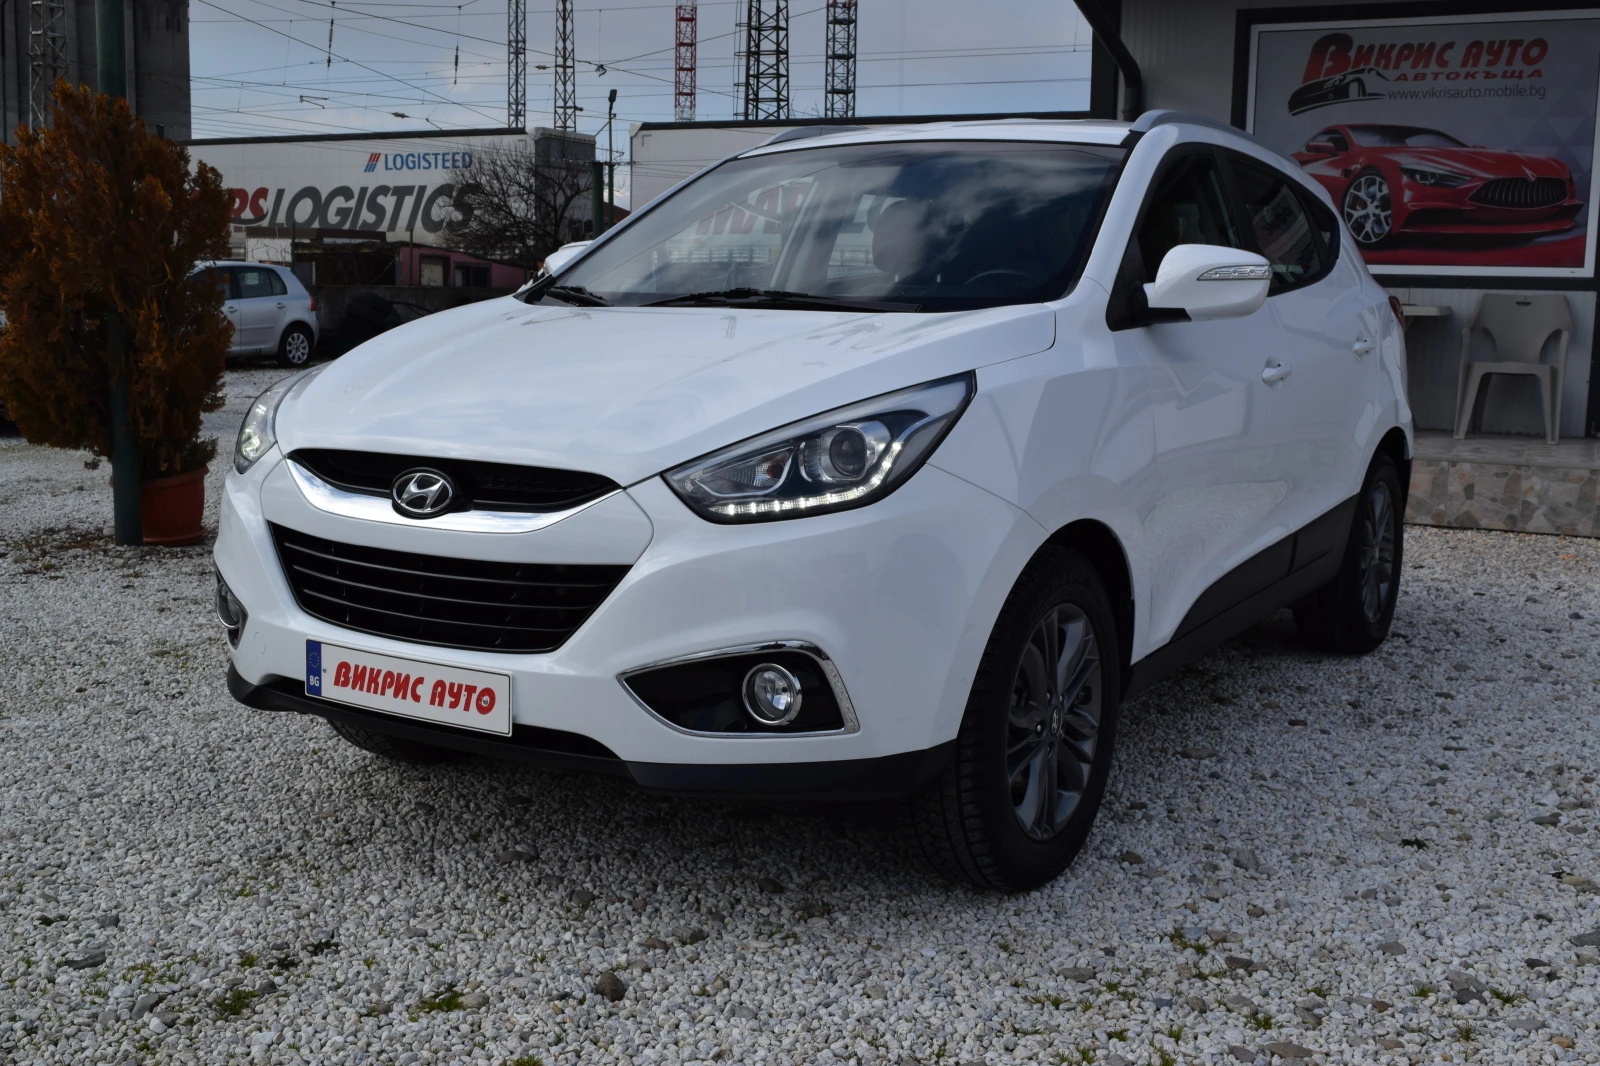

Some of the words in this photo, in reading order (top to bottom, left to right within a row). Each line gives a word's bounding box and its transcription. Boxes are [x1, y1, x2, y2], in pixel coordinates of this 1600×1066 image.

[1302, 32, 1456, 83] ВИКРИС
[1460, 37, 1549, 69] АУТО
[1395, 68, 1544, 83] АВТОКЪЩА
[1387, 84, 1547, 101] www.vikrisauto.mobile.bg
[384, 151, 473, 171] LOGISTEED
[309, 675, 320, 687] BG
[333, 661, 425, 703] ВИКРИС
[429, 679, 497, 715] АУТО
